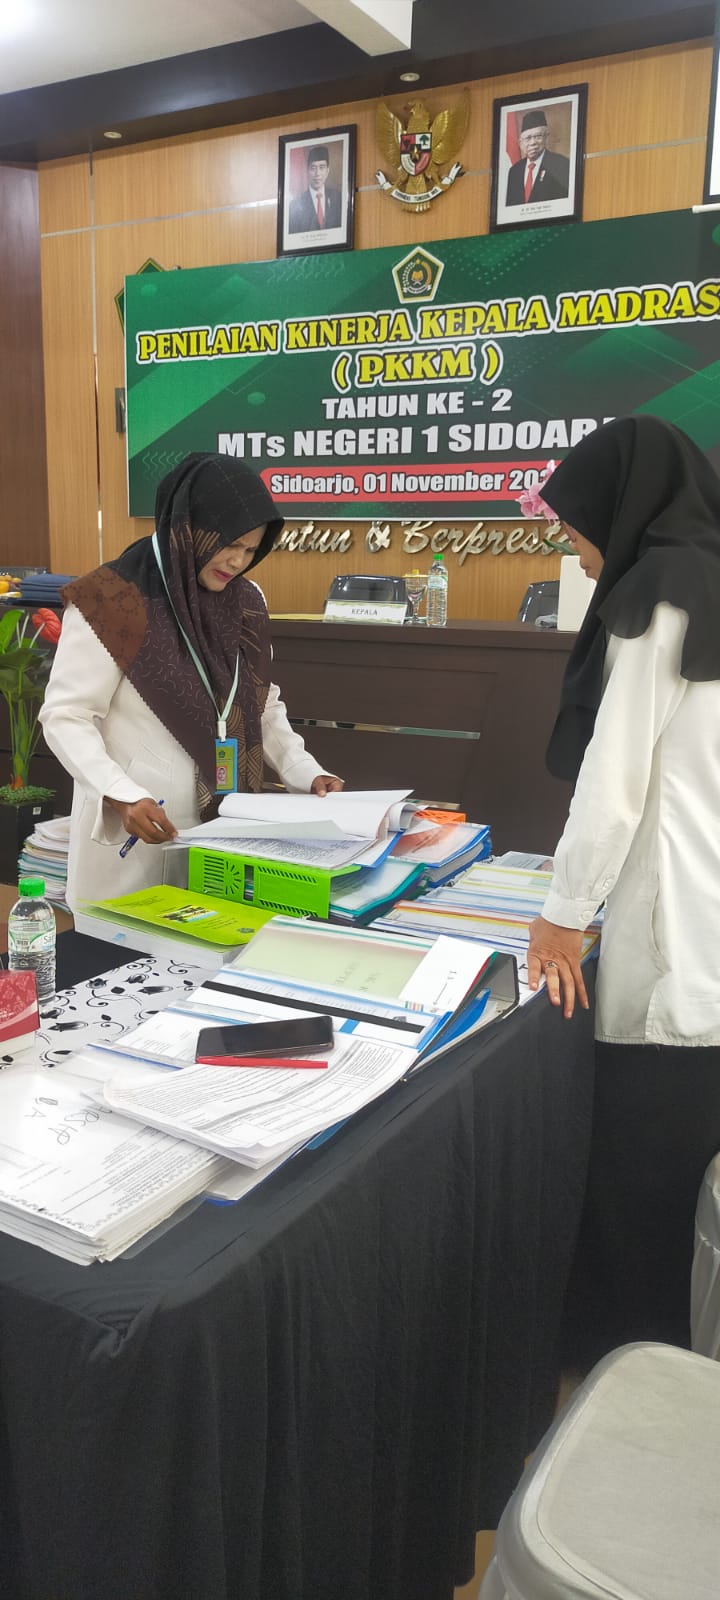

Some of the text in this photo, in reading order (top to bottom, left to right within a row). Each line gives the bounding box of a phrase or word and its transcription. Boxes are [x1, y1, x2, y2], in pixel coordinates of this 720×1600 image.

[138, 281, 720, 362] PENILAIAN KINERJA KEPALA MADRAS
[358, 347, 472, 384] PKKM
[321, 393, 419, 420] TAHUN
[426, 391, 465, 416] KE
[491, 388, 513, 412] 2
[217, 416, 617, 458] MTs NEGERI 1 SIDOAR
[270, 473, 359, 495] Sidoarjo,
[363, 472, 387, 494] 01
[391, 471, 505, 493] November
[272, 520, 353, 554] ntun
[351, 608, 378, 616] KEPALA
